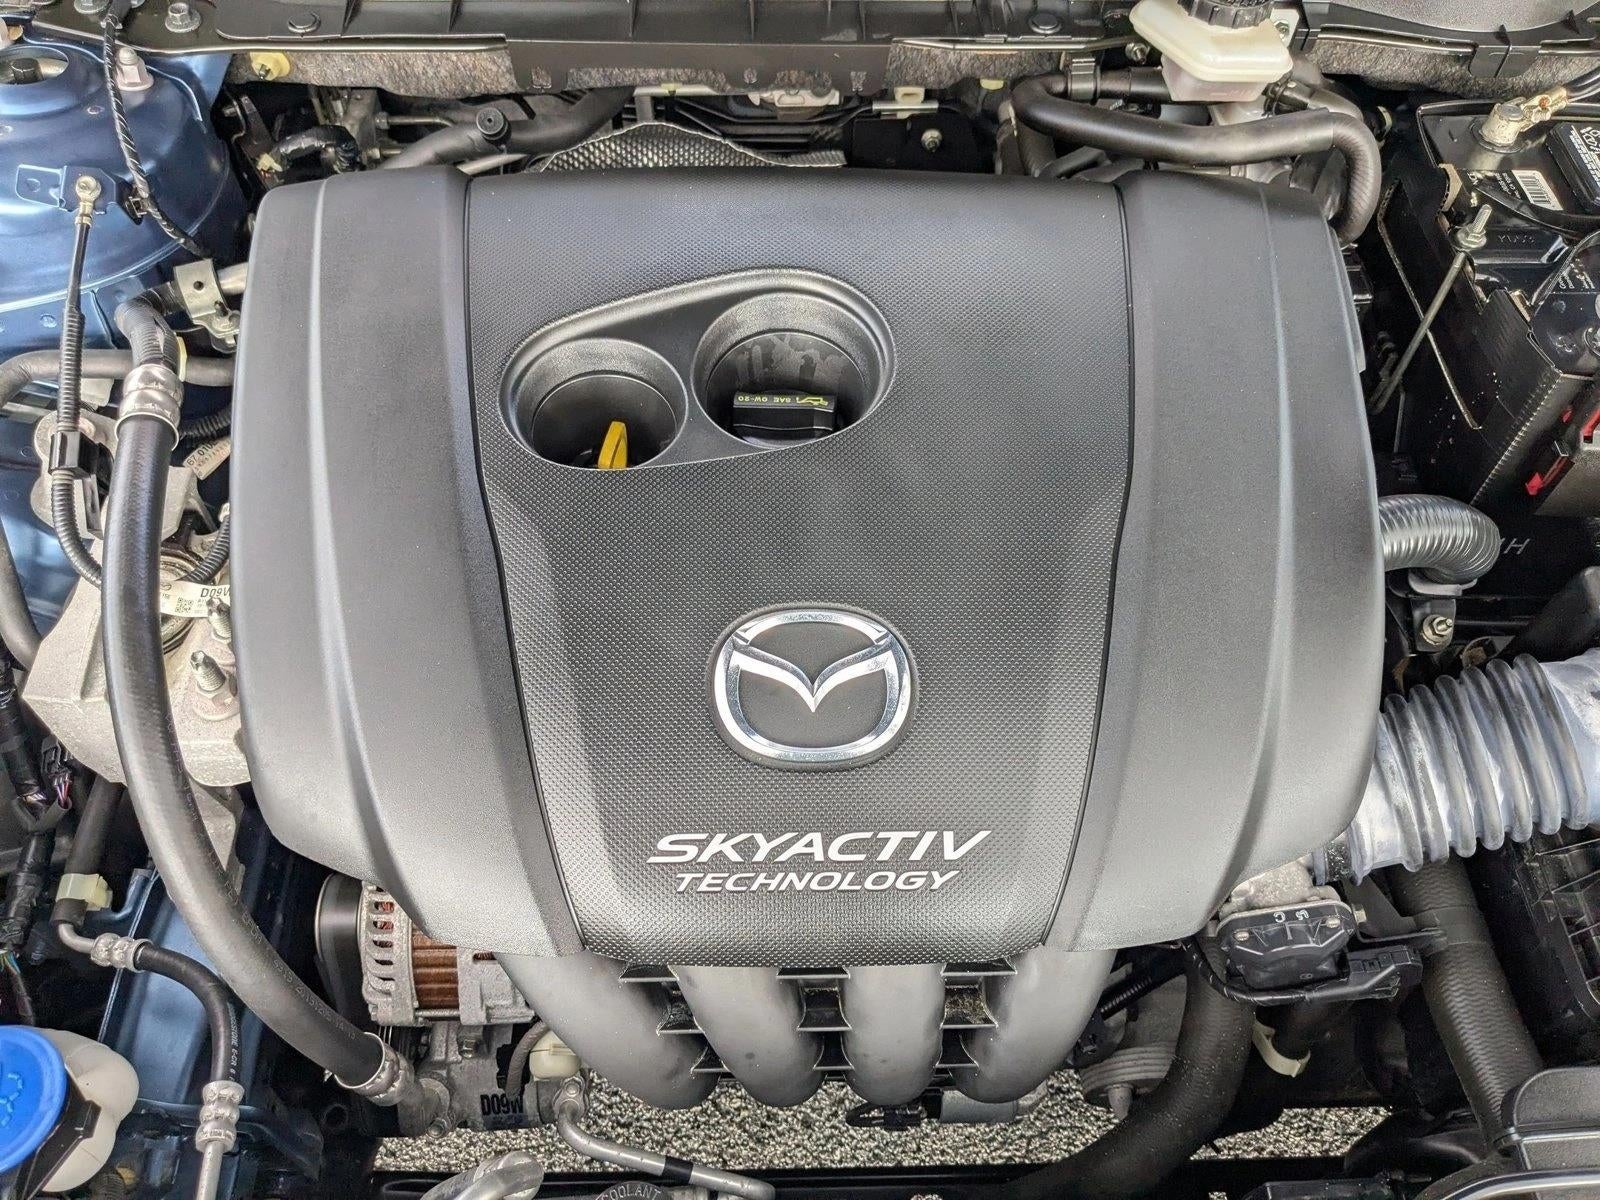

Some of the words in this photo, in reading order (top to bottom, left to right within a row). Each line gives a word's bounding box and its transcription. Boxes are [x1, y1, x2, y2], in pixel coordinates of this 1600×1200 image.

[737, 395, 768, 403] 0W-20
[646, 830, 992, 864] SKYACTIV
[675, 870, 960, 893] TECHNOLOGY
